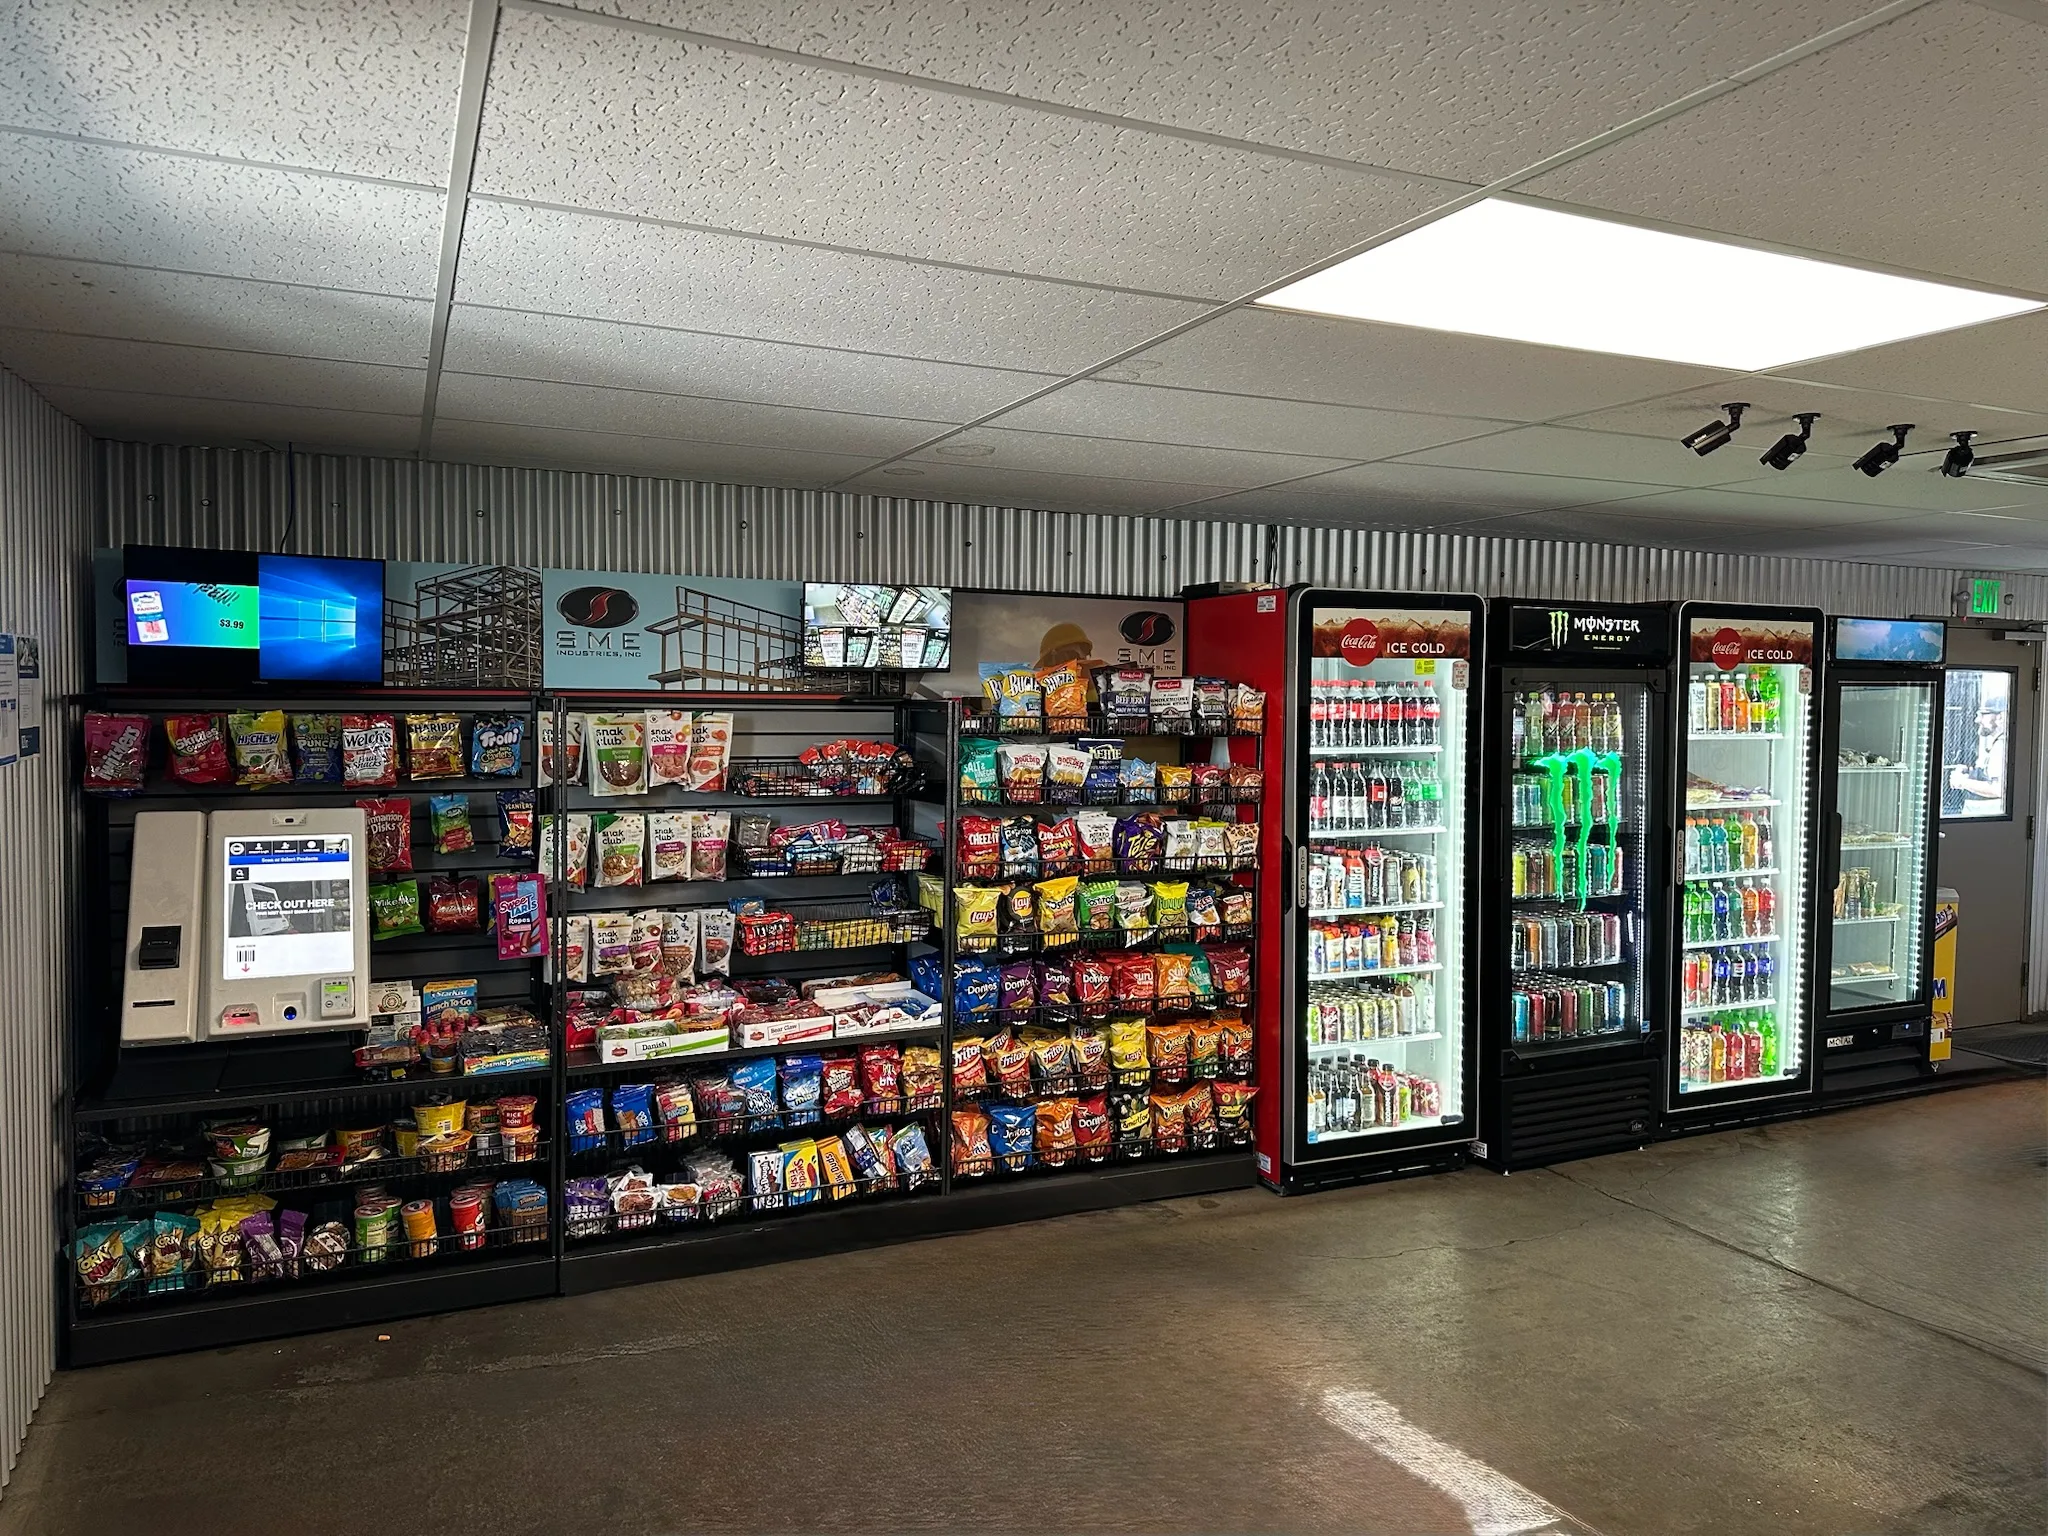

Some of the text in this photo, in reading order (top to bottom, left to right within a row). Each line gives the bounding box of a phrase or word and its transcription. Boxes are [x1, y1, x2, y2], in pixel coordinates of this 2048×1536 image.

[1973, 579, 2000, 613] EXIT
[219, 618, 244, 629] $3.99
[556, 631, 641, 650] SME
[1583, 634, 1631, 642] ENERGY
[1386, 643, 1445, 654] ICE COLD
[1117, 649, 1176, 664] SME
[1747, 650, 1793, 660] ICE COLD
[480, 728, 519, 748] Trolli
[596, 727, 623, 737] snak
[175, 727, 219, 750] Skittles
[344, 730, 391, 747] Welch's
[597, 737, 622, 747] club
[297, 739, 339, 751] PUNCH
[1014, 756, 1041, 766] BOULDER
[367, 813, 402, 825] innamon
[371, 821, 396, 834] Disks
[602, 836, 623, 844] club
[1350, 867, 1362, 899] PRIME
[245, 899, 335, 911] CHECK OUT HERE
[436, 990, 468, 998] StarKist
[967, 981, 997, 995] Doritos
[426, 1001, 450, 1014] Lunch
[771, 1026, 783, 1034] Bear
[784, 1024, 798, 1032] Claw
[641, 1041, 667, 1051] Danish
[1001, 1050, 1026, 1066] Fritos
[1079, 1115, 1106, 1128] Doritos
[826, 1152, 839, 1173] Duds
[789, 1169, 797, 1188] Fish
[570, 1204, 601, 1214] BIG
[77, 1241, 110, 1275] CORN
